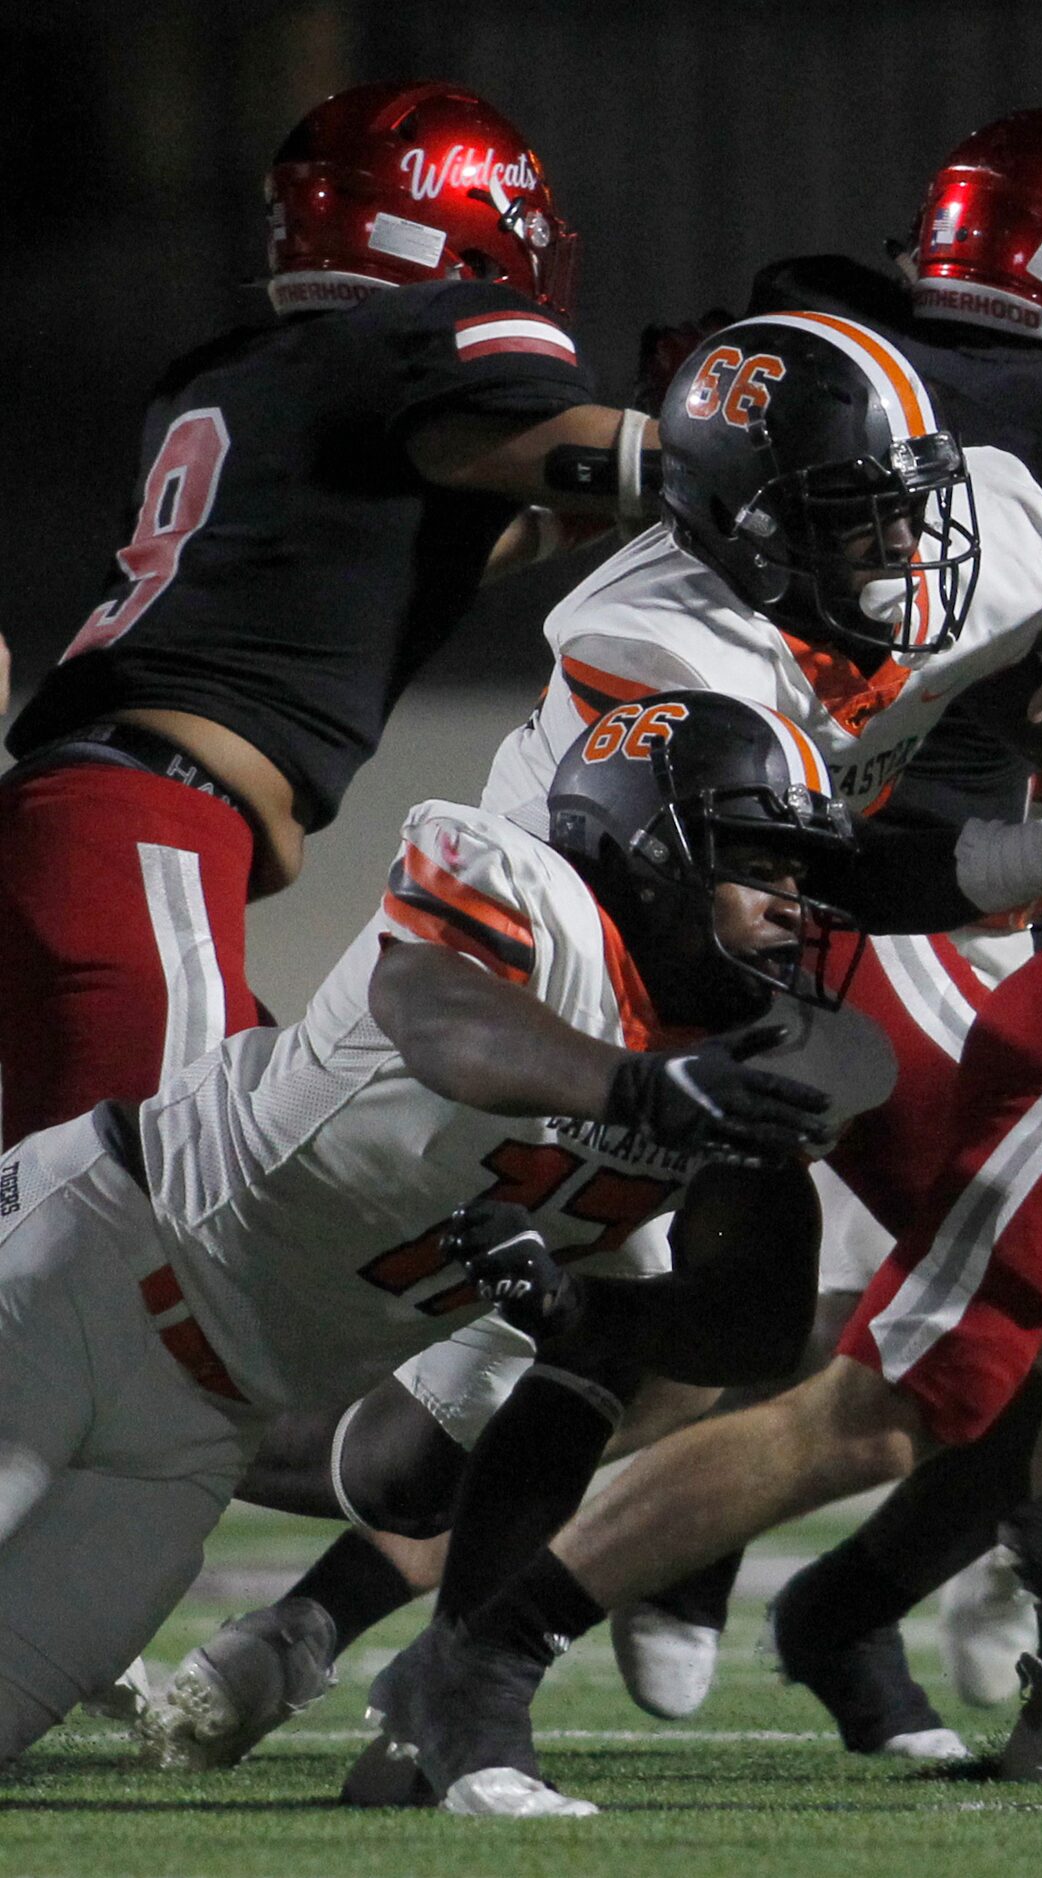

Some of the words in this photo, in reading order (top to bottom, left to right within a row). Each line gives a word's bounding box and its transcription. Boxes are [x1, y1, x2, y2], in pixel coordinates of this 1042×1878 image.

[401, 145, 538, 201] Wildcats
[686, 345, 786, 429] 66
[57, 407, 231, 666] 9
[581, 702, 690, 765] 66
[0, 1160, 21, 1217] TIGERS
